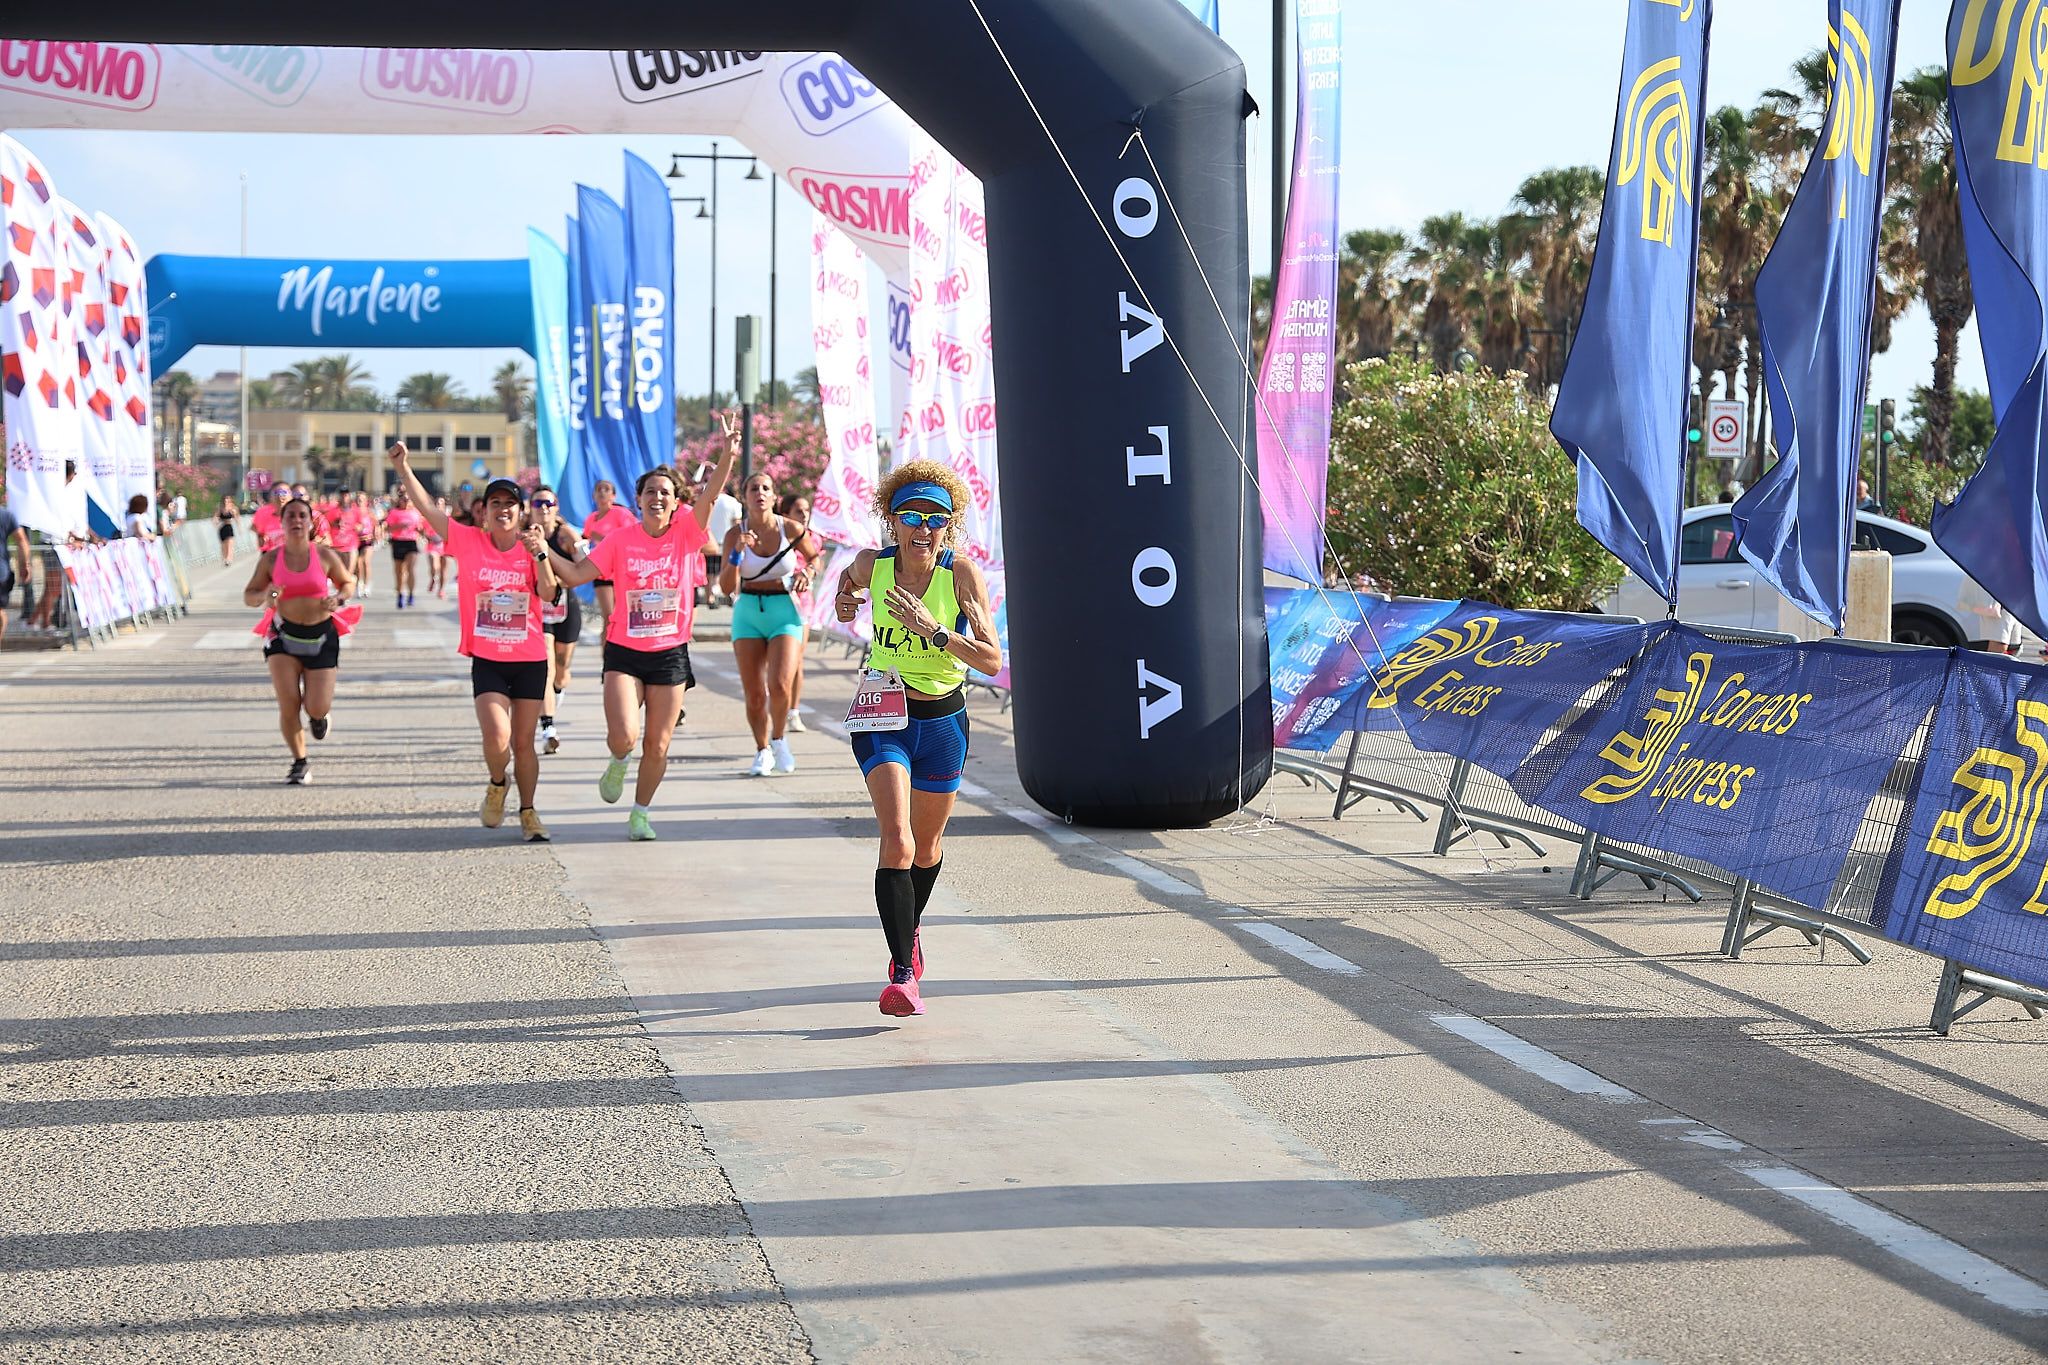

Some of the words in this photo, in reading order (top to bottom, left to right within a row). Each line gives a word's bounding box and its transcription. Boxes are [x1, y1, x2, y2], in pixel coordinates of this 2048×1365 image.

[1, 38, 144, 101] COSMO
[377, 48, 518, 107] COSMO
[797, 59, 876, 121] COS
[801, 178, 910, 236] COSM
[1718, 423, 1733, 434] 30
[1113, 177, 1183, 739] VOLVO
[479, 567, 526, 586] CARRERA
[491, 612, 512, 622] 016
[642, 610, 663, 620] 016
[858, 692, 882, 706] 016
[1699, 672, 1813, 735] Correos
[1650, 742, 1756, 814] Express
